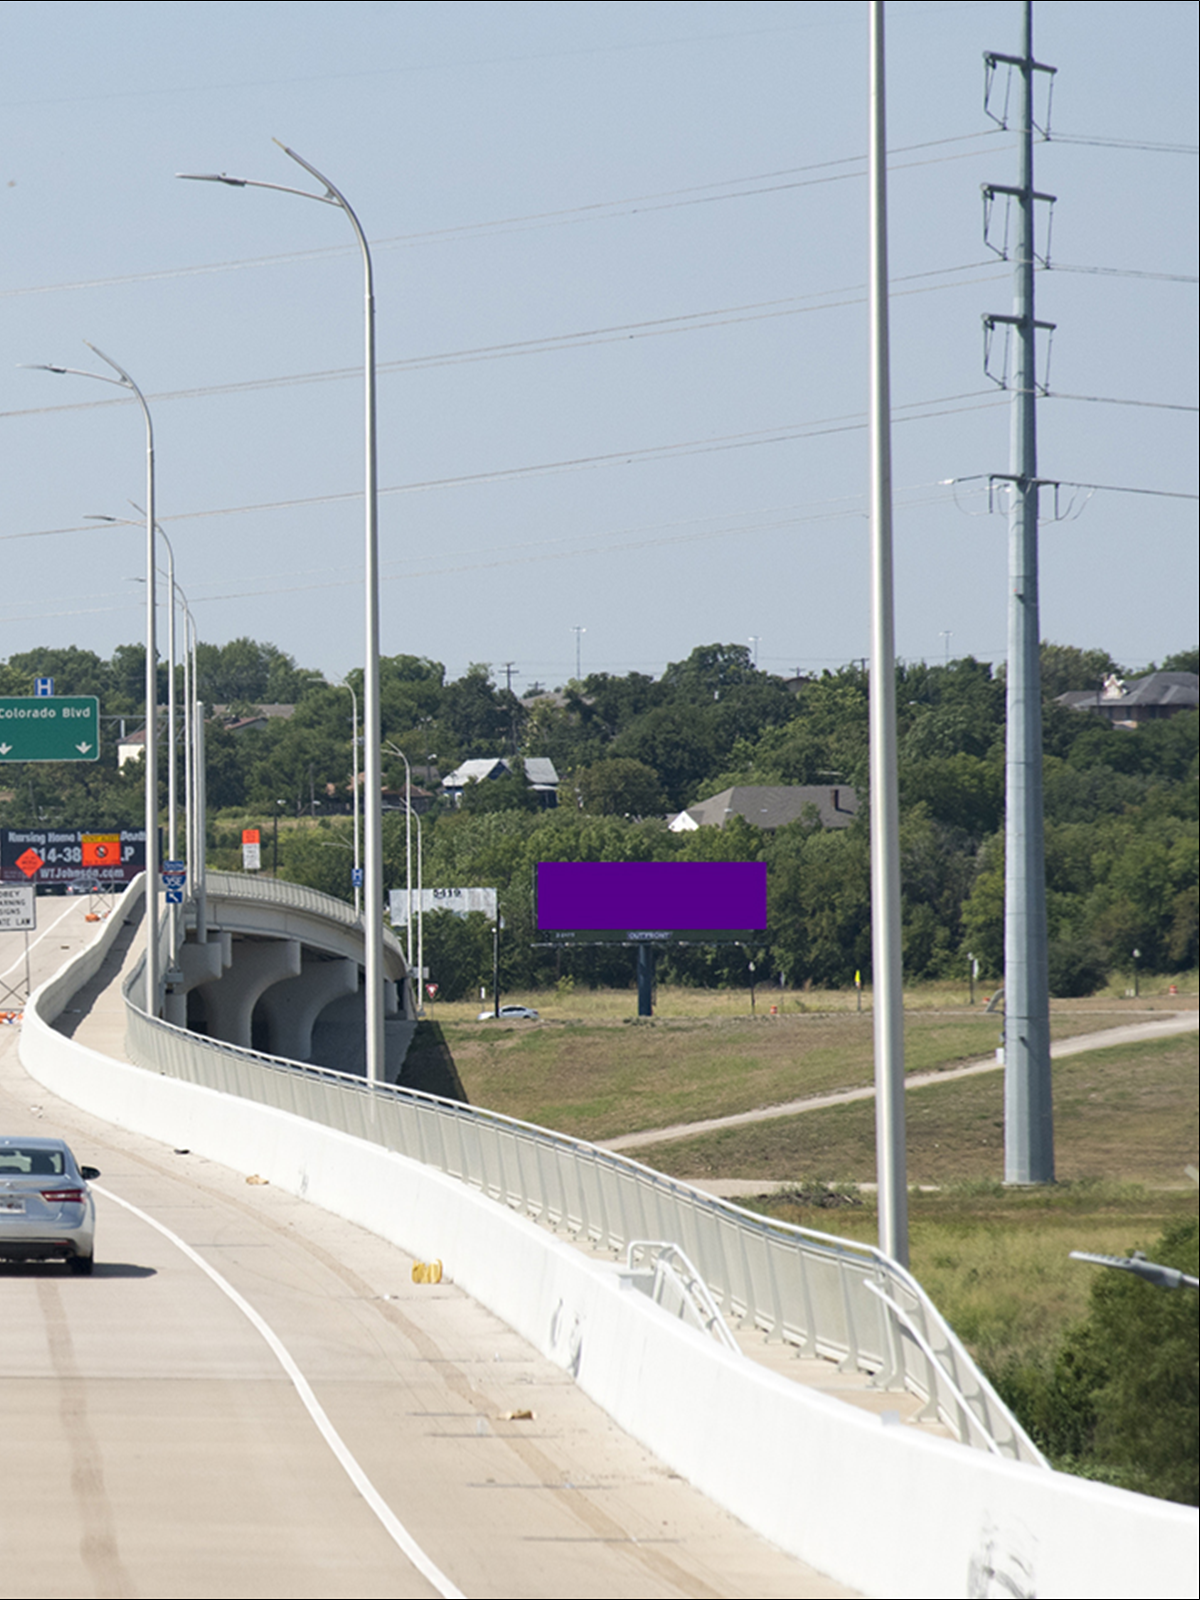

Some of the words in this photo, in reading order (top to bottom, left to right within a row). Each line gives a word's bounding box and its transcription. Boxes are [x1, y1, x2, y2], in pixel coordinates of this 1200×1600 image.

[62, 707, 90, 718] Blvd
[48, 832, 75, 842] Home
[16, 918, 31, 926] LAW
